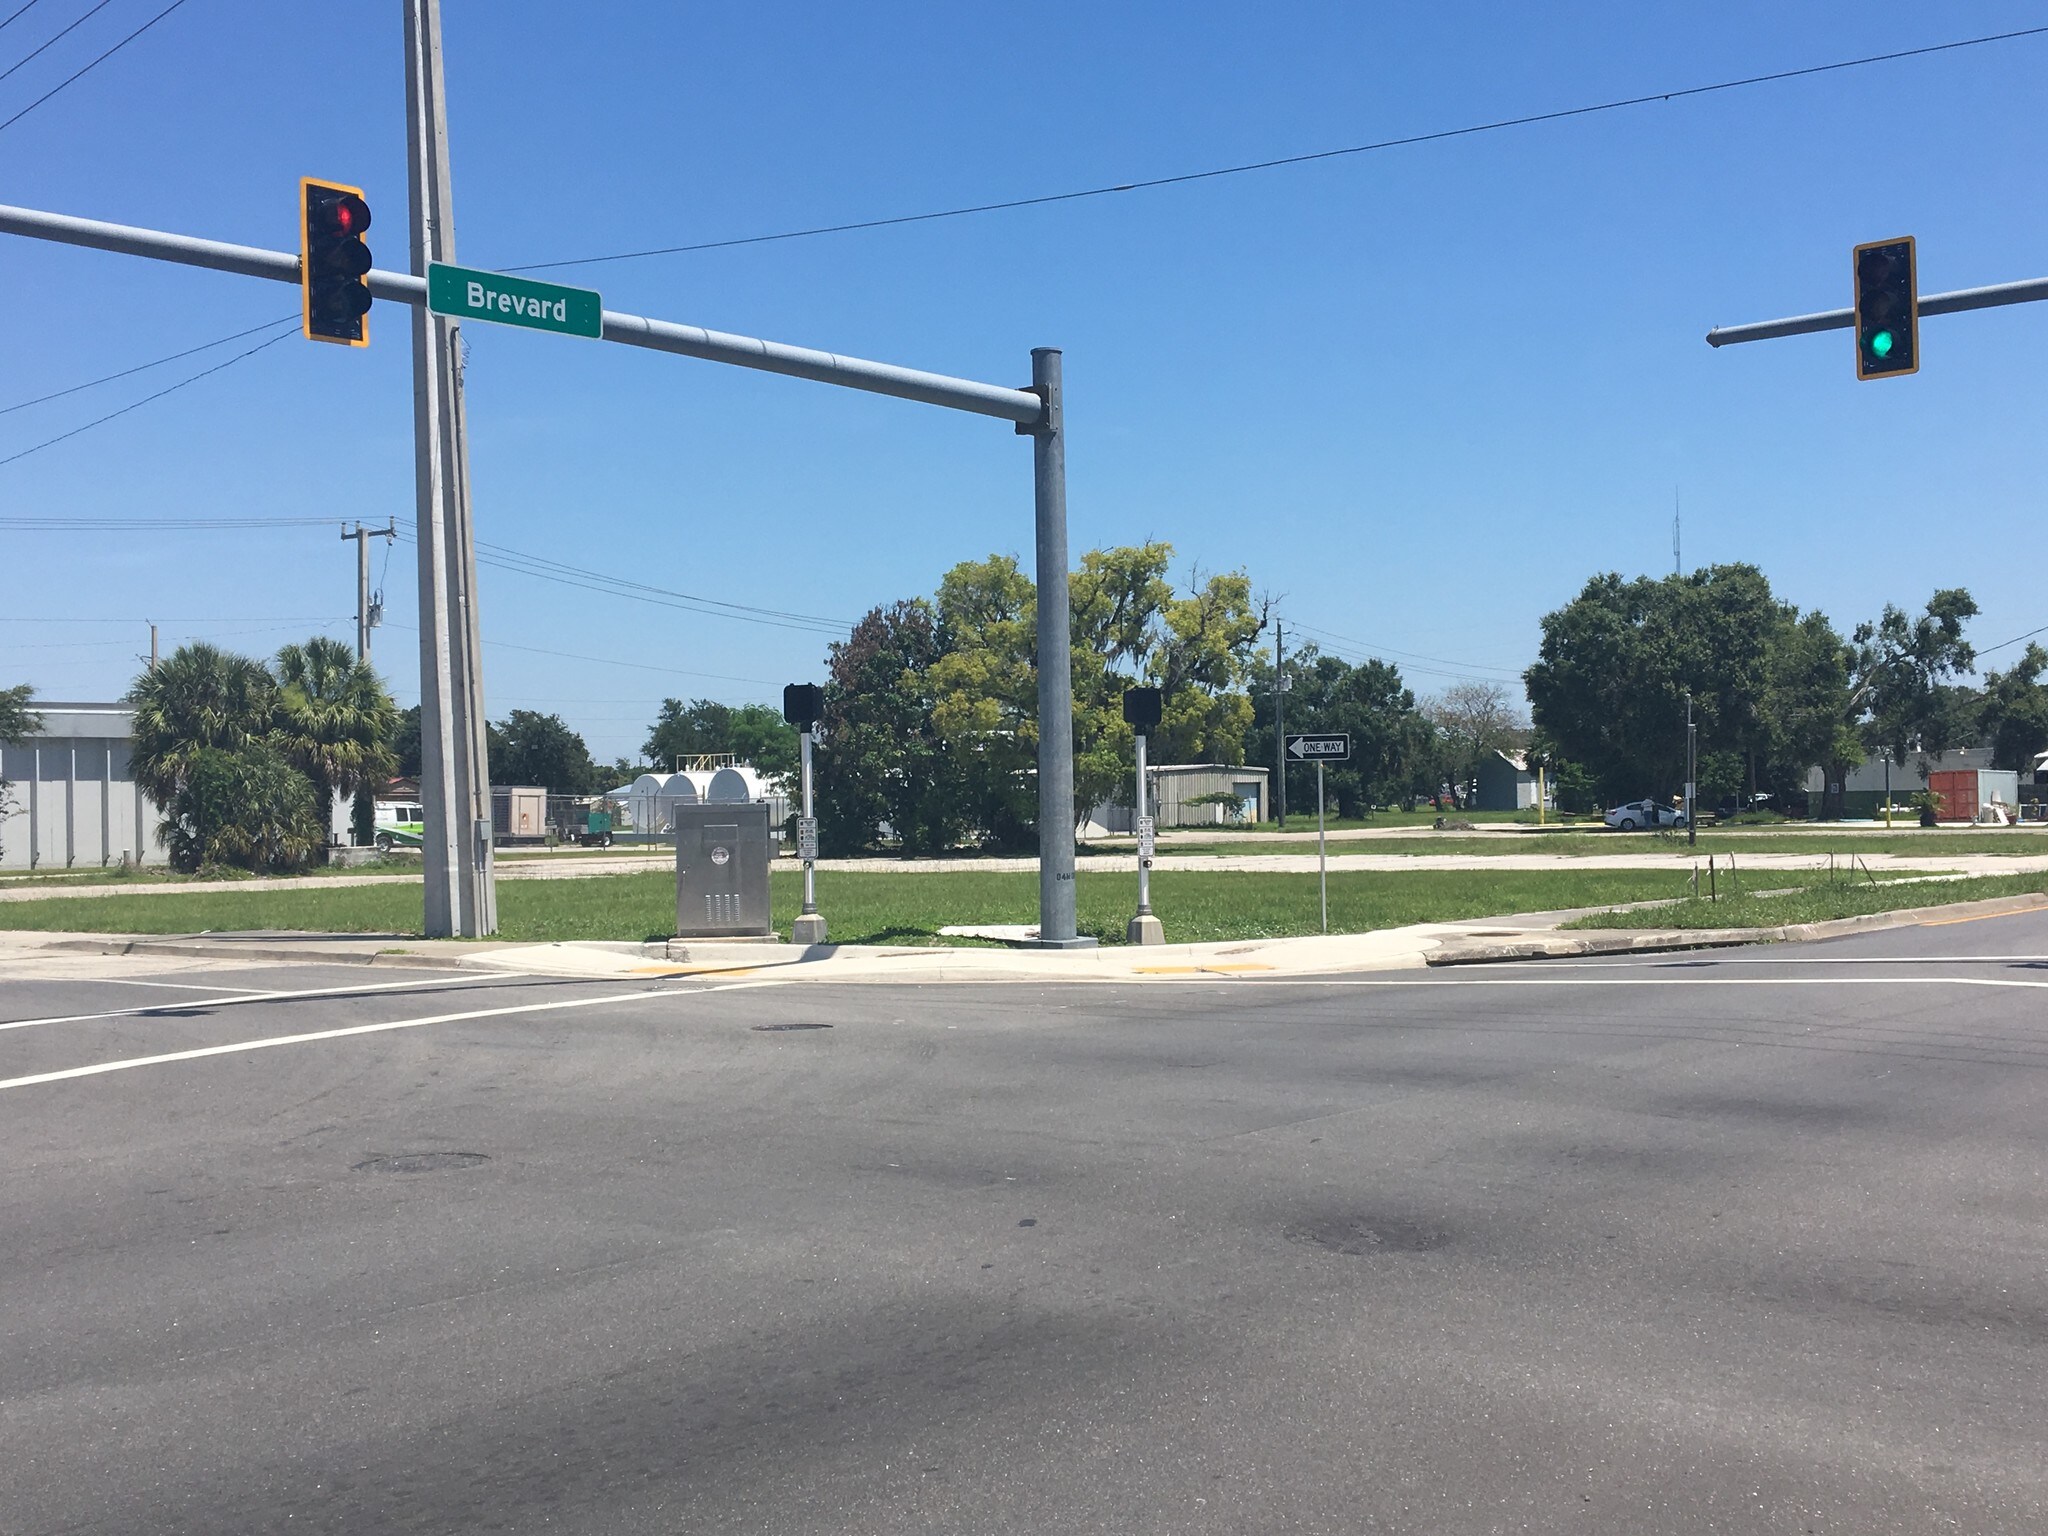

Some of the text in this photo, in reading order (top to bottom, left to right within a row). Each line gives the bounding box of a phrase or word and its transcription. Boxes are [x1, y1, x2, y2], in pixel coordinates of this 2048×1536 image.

[467, 281, 566, 322] Brevard
[1303, 742, 1342, 753] ONE WAY
